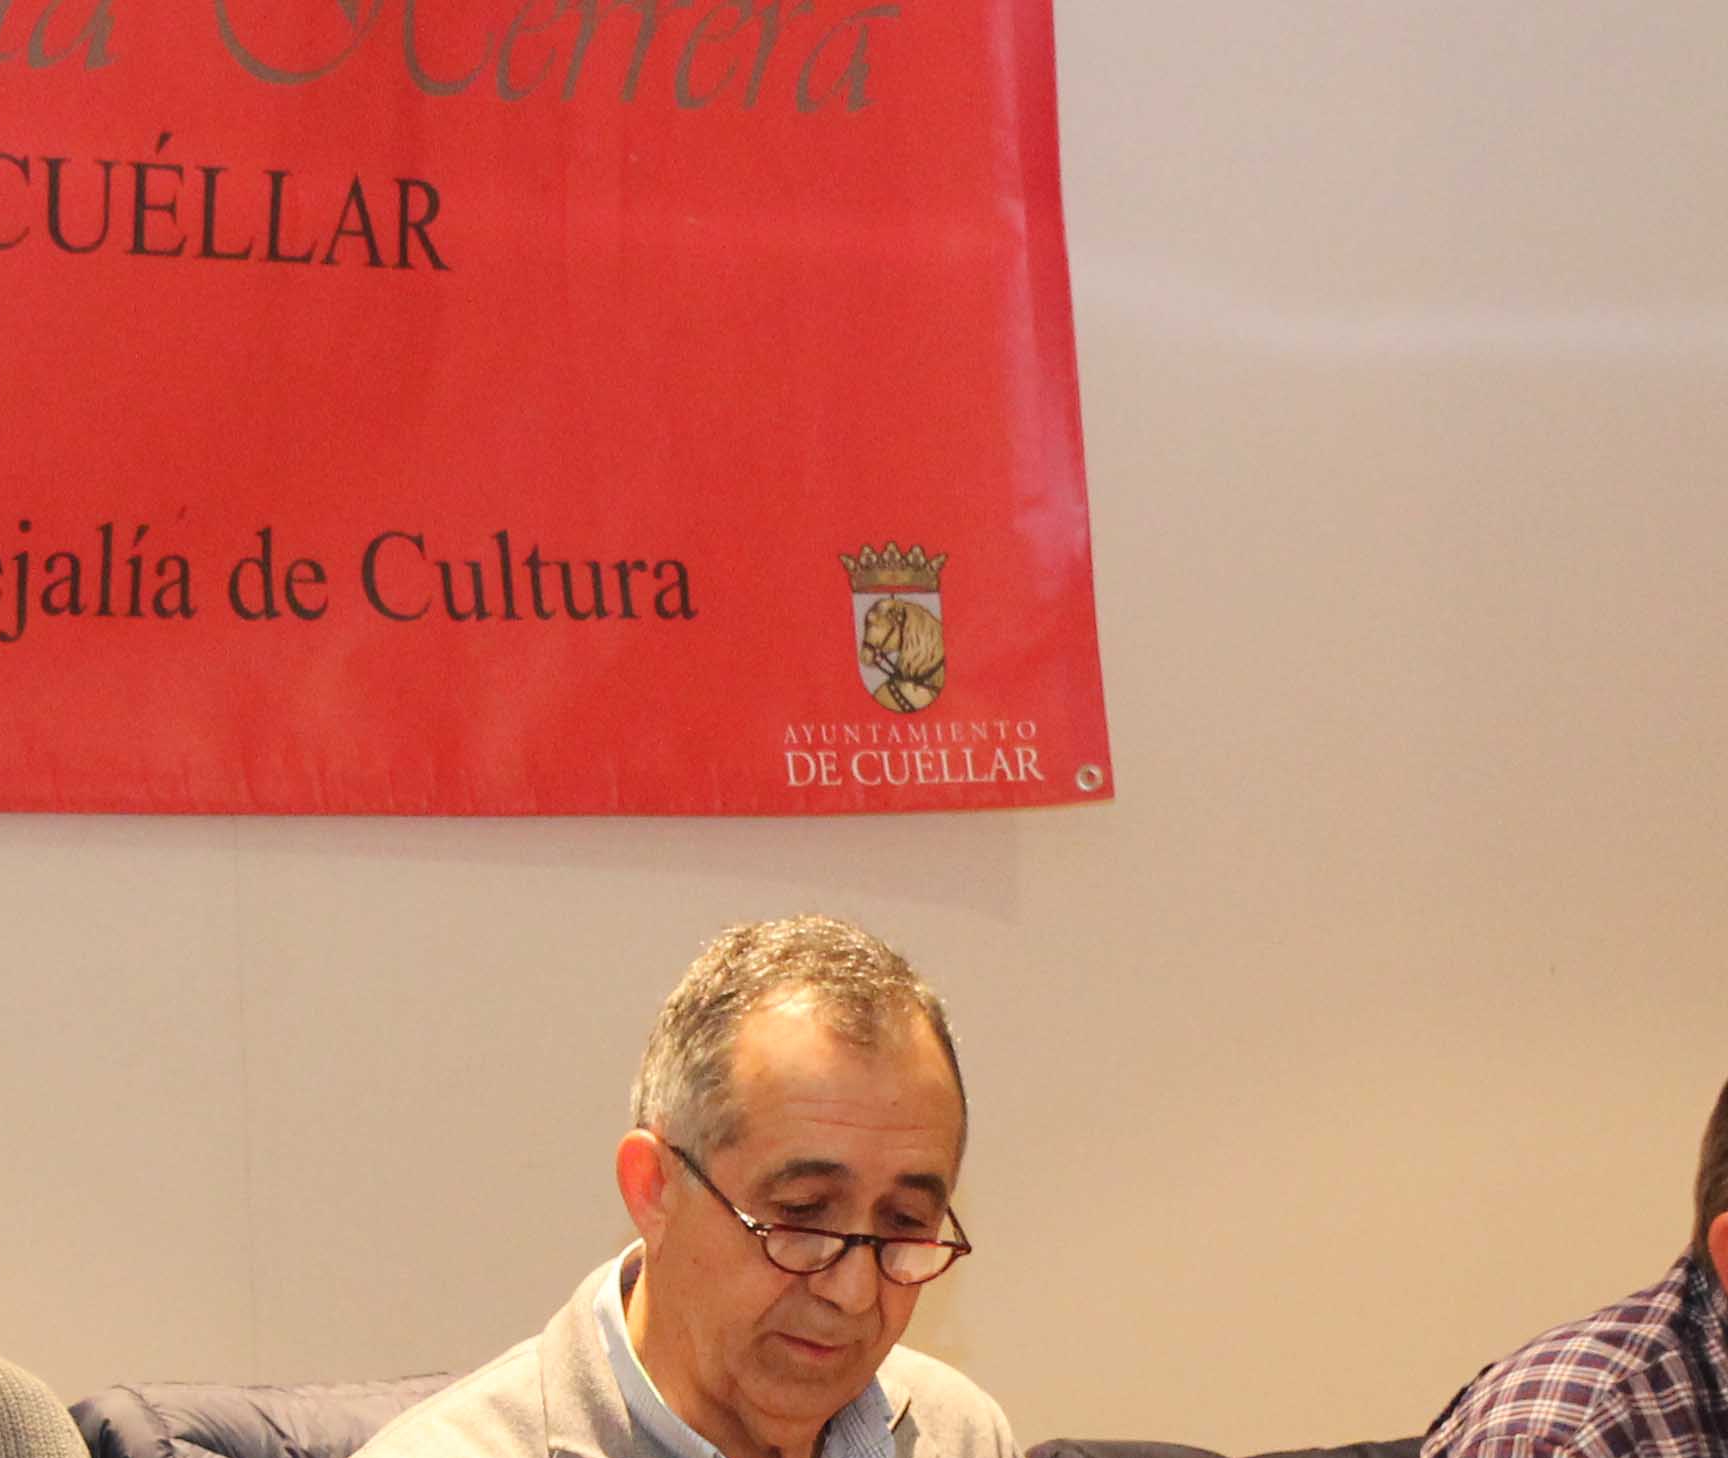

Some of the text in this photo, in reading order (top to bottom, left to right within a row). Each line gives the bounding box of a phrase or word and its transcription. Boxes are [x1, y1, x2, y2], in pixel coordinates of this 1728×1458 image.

[227, 526, 329, 622] de
[360, 529, 699, 623] Cultura
[783, 719, 1038, 746] AYUNTAMIENTO
[784, 744, 1046, 788] DE CUÉLLAR
